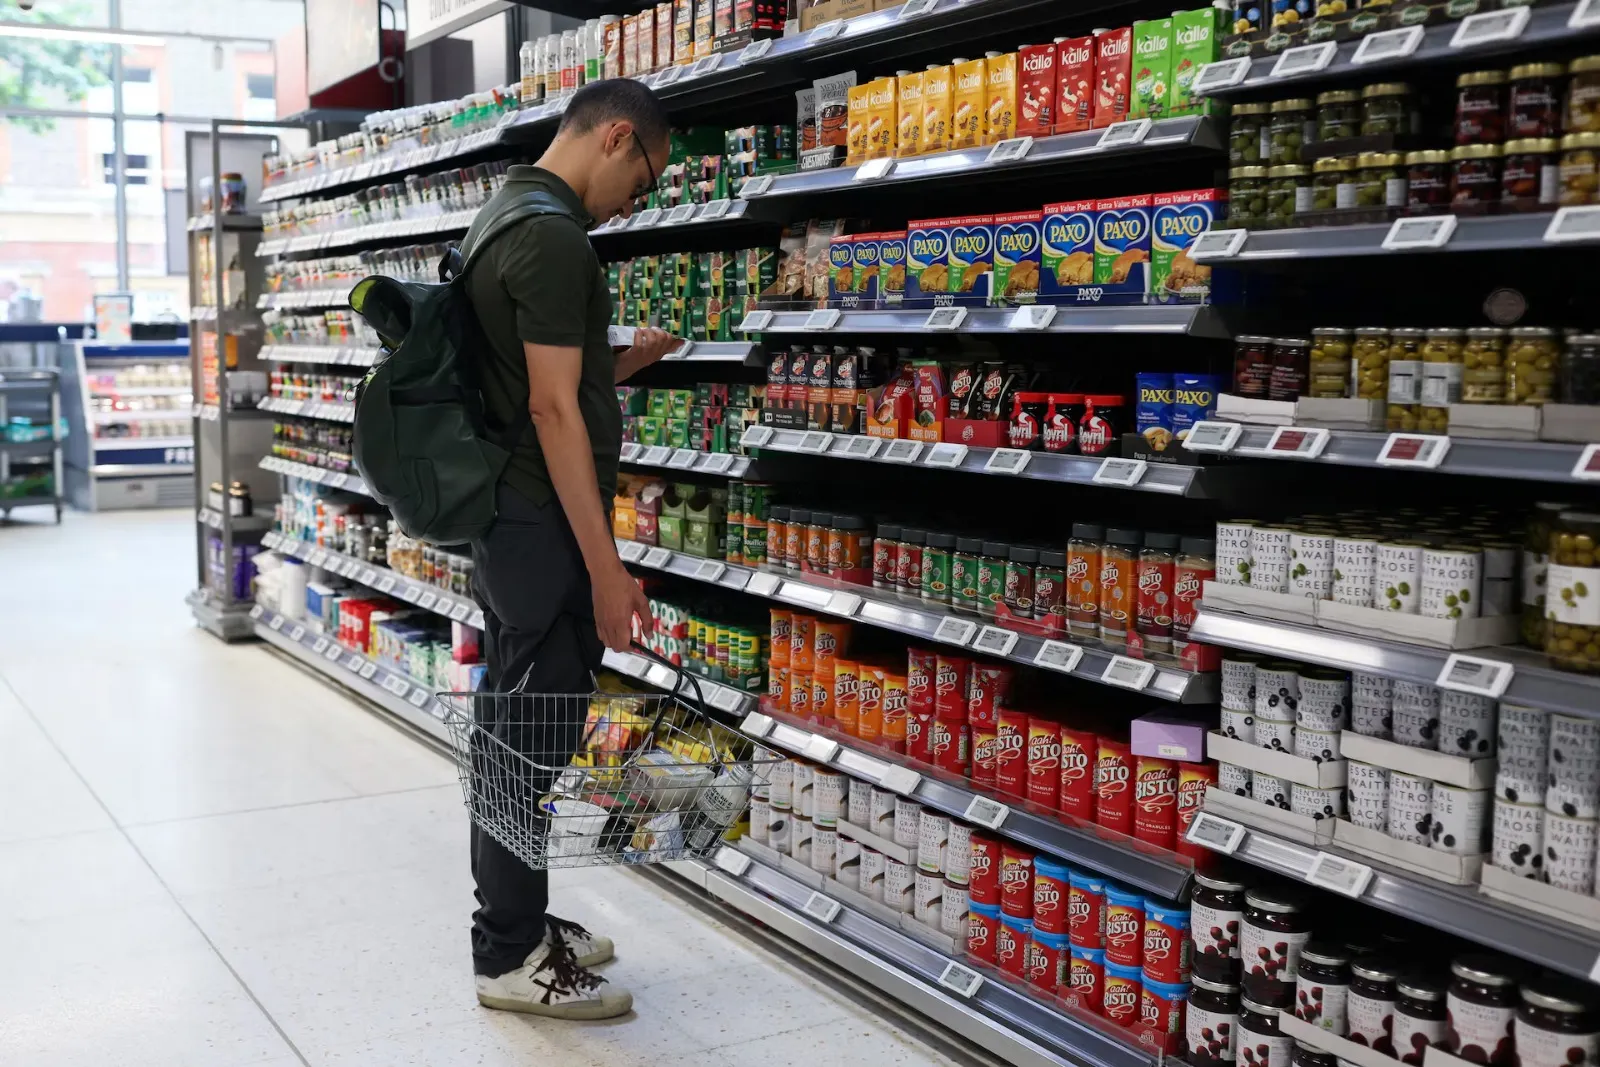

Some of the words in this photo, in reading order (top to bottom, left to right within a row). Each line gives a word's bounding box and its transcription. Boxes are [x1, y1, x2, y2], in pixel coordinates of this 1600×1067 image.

[1097, 202, 1112, 210] Extra
[1114, 200, 1130, 208] Value
[1131, 198, 1148, 207] Pack
[1154, 196, 1171, 205] Extra
[1172, 195, 1191, 203] Value
[1192, 192, 1210, 202] Pack
[1044, 206, 1058, 214] Extra
[1060, 204, 1076, 212] Value
[1076, 203, 1092, 211] Pack
[1104, 220, 1140, 240] PAXO
[1161, 215, 1202, 236] PAXO
[1050, 224, 1085, 243] PAXO
[914, 239, 942, 256] PAXO
[955, 236, 985, 253] PAXO
[1000, 234, 1032, 252] PAXO
[1077, 287, 1102, 301] PAXO
[953, 376, 971, 390] BISTO
[984, 378, 1002, 391] BISTO
[1176, 390, 1212, 406] PAXO
[869, 426, 881, 436] POUR
[882, 427, 894, 437] OVER
[924, 430, 938, 440] OVER
[1044, 423, 1068, 443] Bovril
[1080, 425, 1104, 446] Bovril
[1067, 562, 1088, 578] BISTO
[1101, 568, 1119, 582] BISTO
[1139, 572, 1162, 590] BISTO
[1174, 580, 1200, 596] BISTO
[1036, 584, 1052, 594] BISTO
[1138, 602, 1156, 616] Best
[1173, 610, 1192, 624] Best
[1030, 733, 1054, 746] aah!
[1100, 756, 1121, 768] aah!
[1144, 768, 1171, 780] aah!
[1350, 765, 1386, 779] ESSEN
[1136, 778, 1178, 800] BISTO
[1183, 778, 1210, 792] aah!
[1350, 778, 1390, 790] WAITR
[1146, 822, 1172, 831] GRANULES
[1112, 912, 1131, 922] aah!
[1106, 920, 1138, 934] BISTO
[1110, 984, 1130, 994] aah!
[1104, 992, 1136, 1007] BISTO
